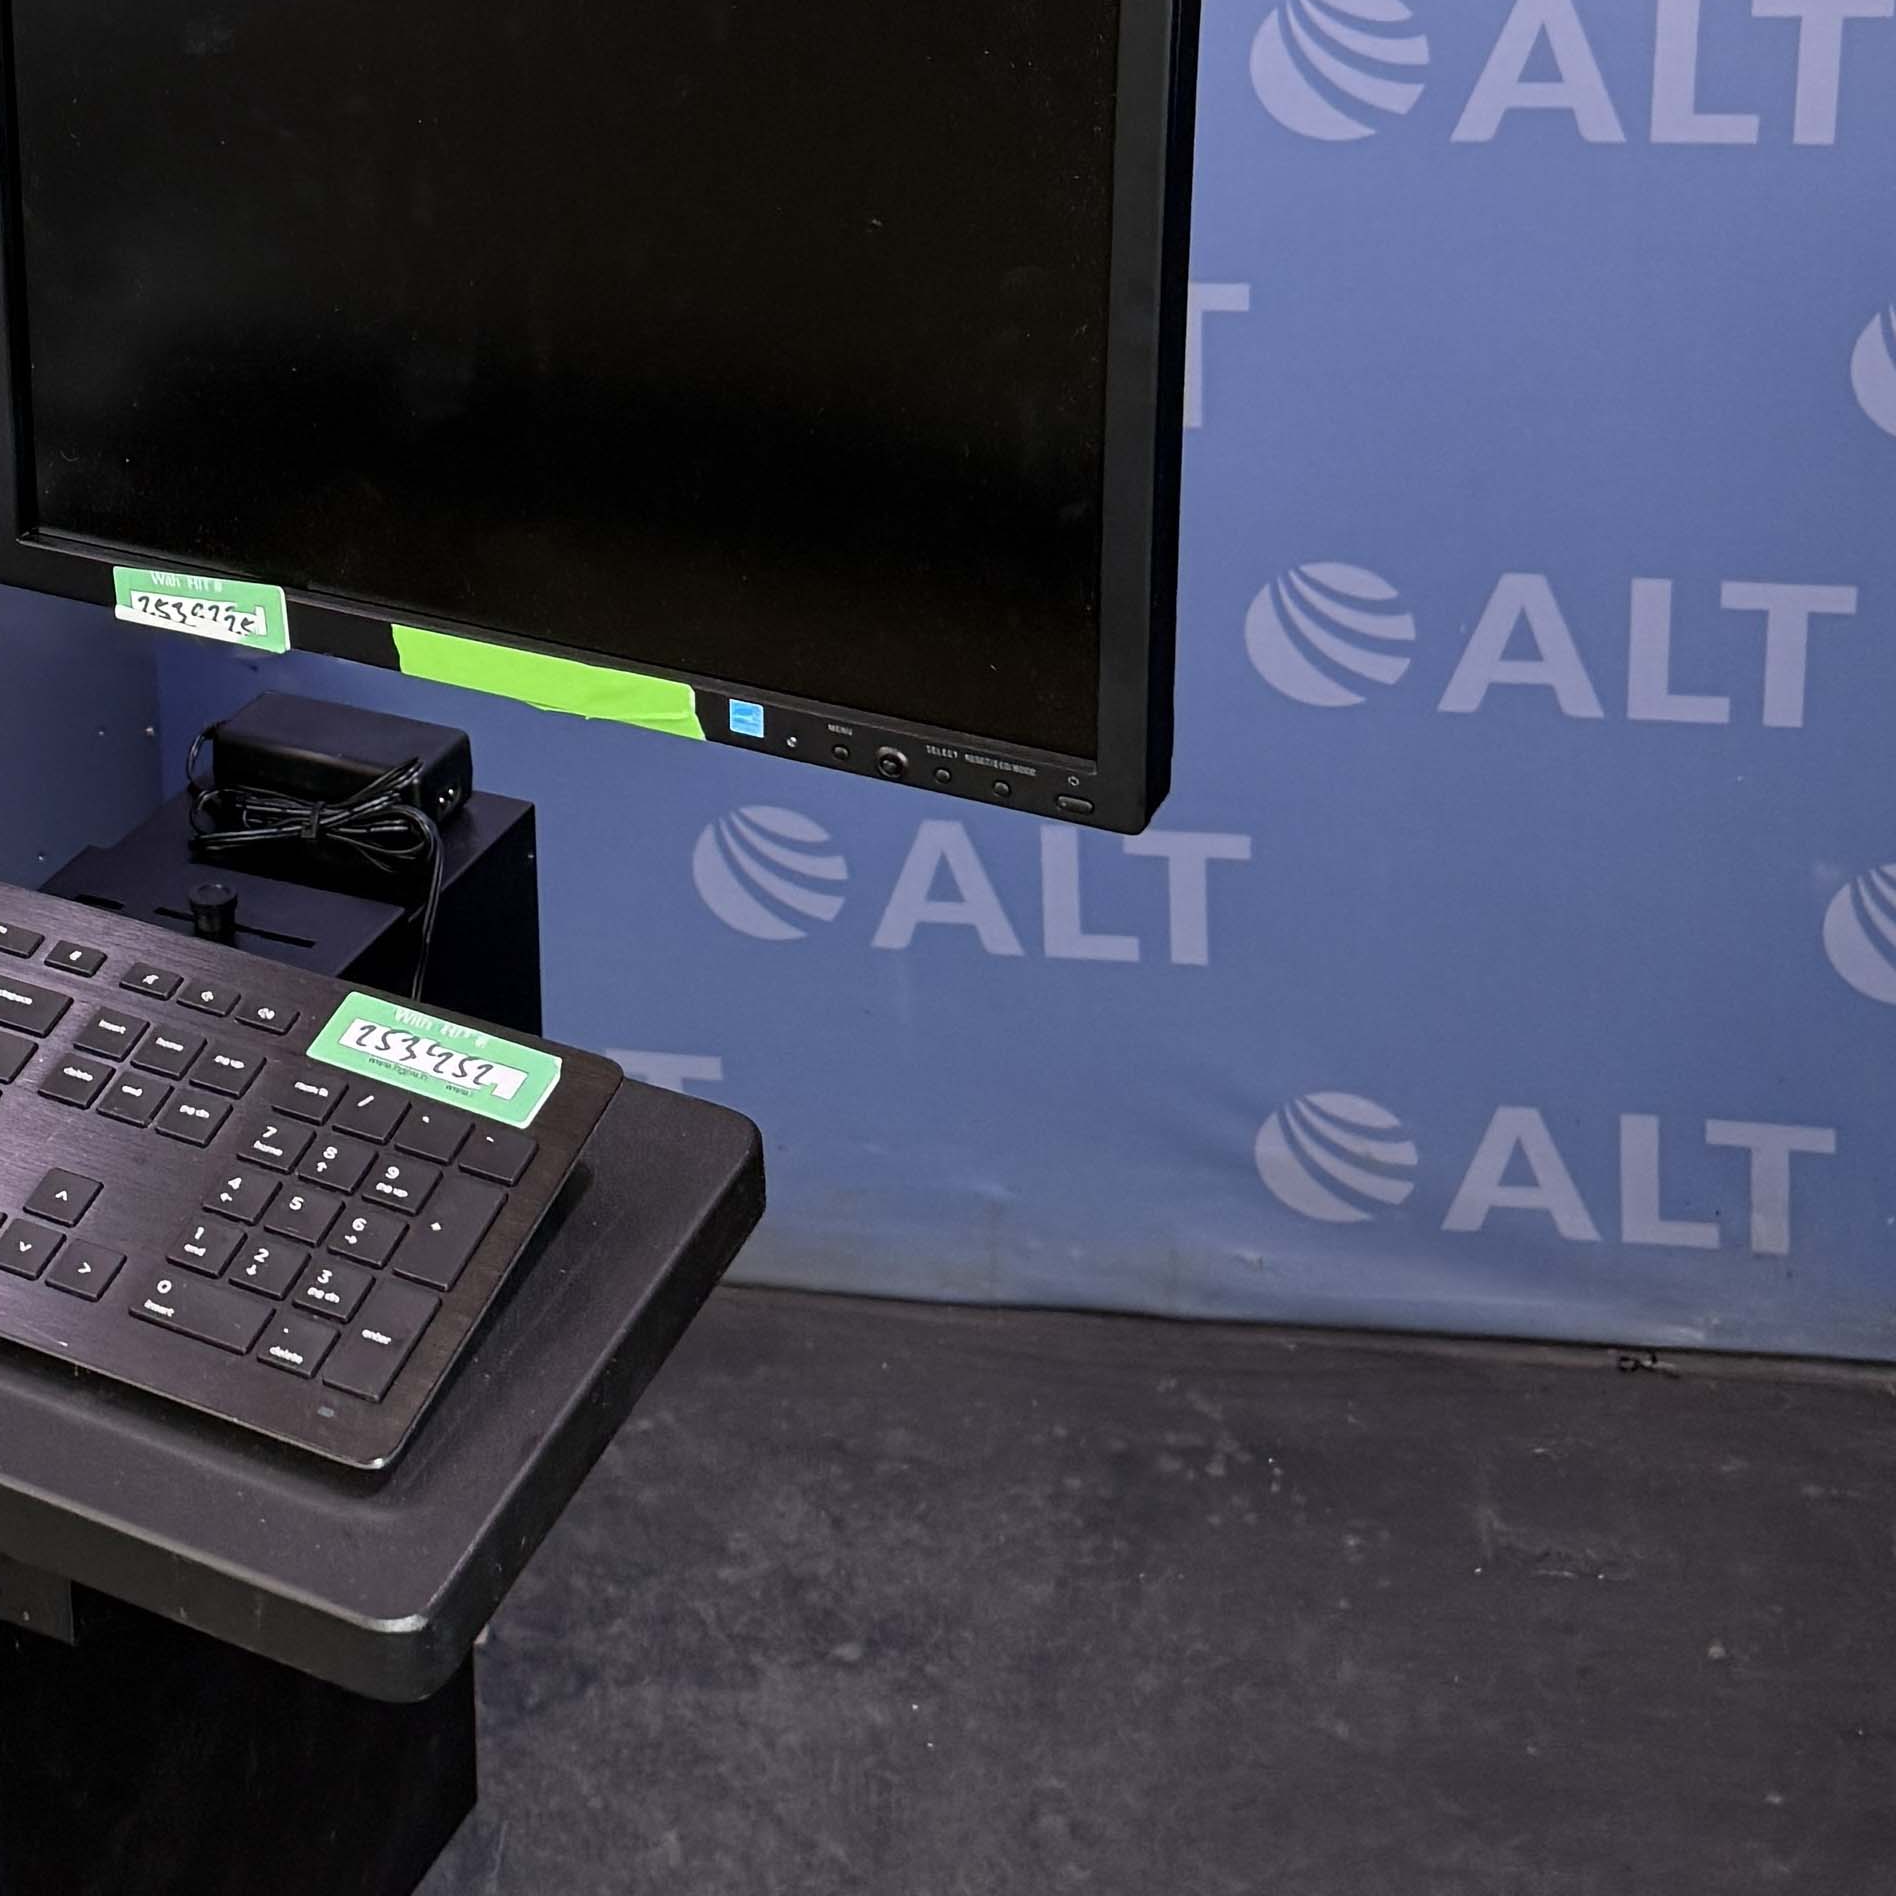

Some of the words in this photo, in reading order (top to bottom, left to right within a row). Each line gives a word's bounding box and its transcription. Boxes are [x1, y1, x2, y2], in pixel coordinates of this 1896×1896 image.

[1437, 572, 1858, 728] ALT
[871, 820, 1251, 966] ALT
[1441, 1106, 1836, 1255] ALT
